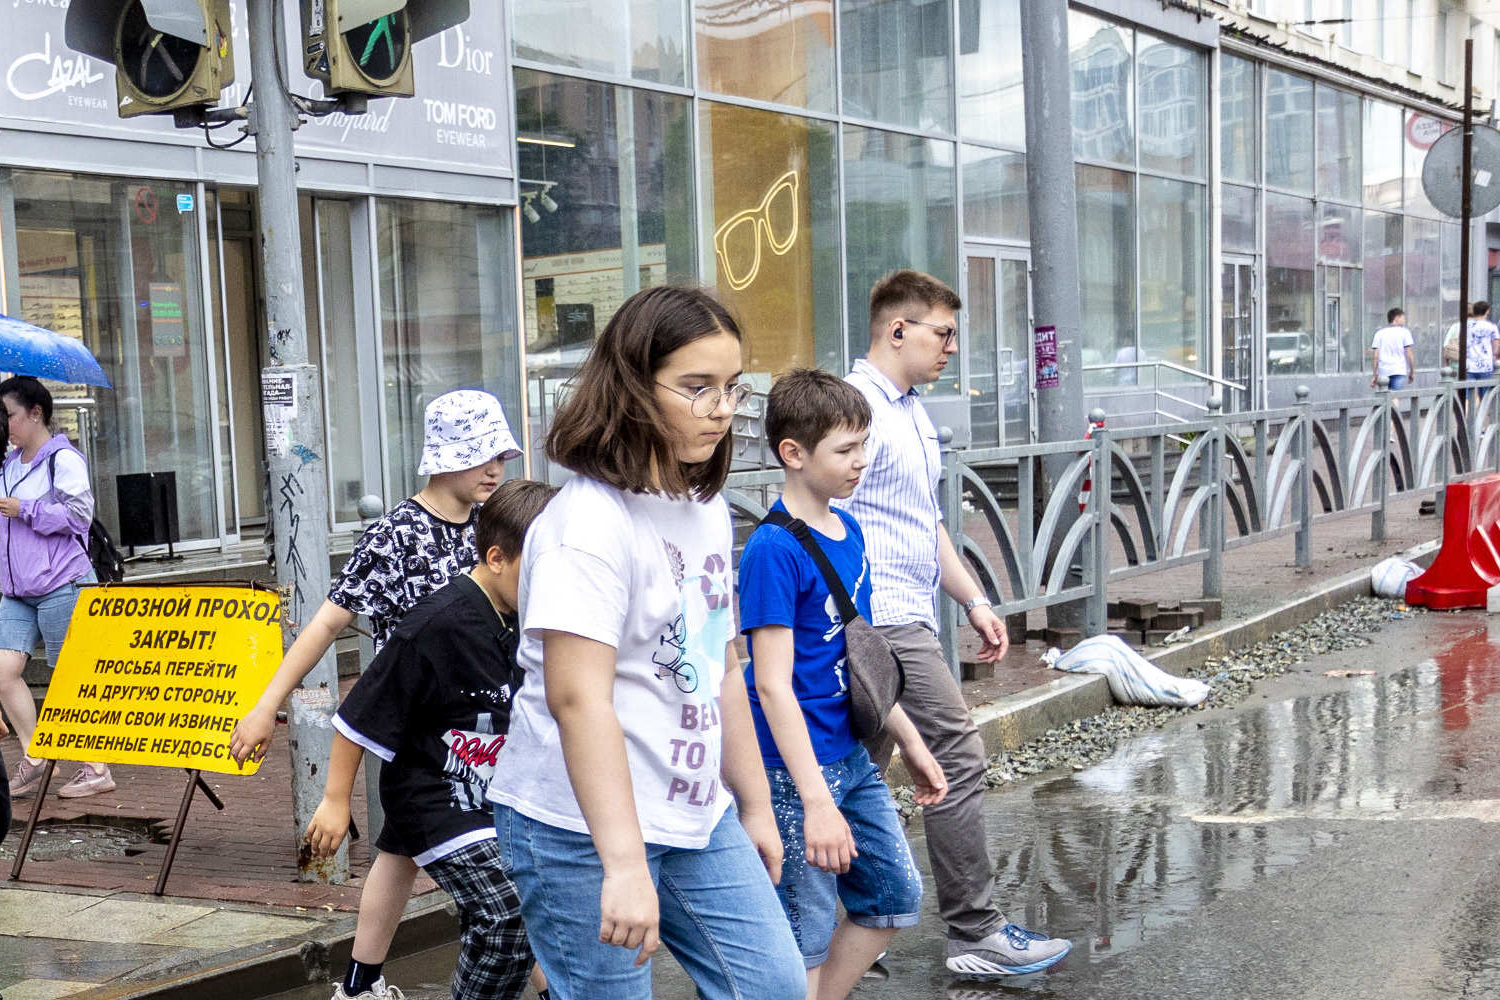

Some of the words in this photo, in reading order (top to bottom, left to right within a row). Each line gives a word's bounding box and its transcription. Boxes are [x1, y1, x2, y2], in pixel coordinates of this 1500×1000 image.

[437, 23, 493, 75] Dior
[6, 32, 104, 100] CAZAL
[67, 95, 109, 110] EYEWEAR
[423, 99, 457, 125] TOM
[458, 103, 496, 131] FORD
[436, 129, 486, 148] EYEWEAR
[88, 593, 191, 618] СКВОЗНОЙ
[128, 629, 217, 650] ЗАКРЫТ!
[94, 659, 161, 676] ПРОСЬБА
[165, 660, 238, 680] ПЕРЕЙТИ
[77, 684, 97, 699] НА
[99, 685, 160, 702] ДРУГУЮ
[163, 686, 239, 707] СТОРОНУ.
[41, 708, 121, 725] ПРИНОСИМ
[124, 711, 165, 729] СВОИ
[168, 713, 239, 733] ИЗВИНЕ
[36, 733, 53, 748] ЗА
[56, 733, 149, 752] ВРЕМЕННЫЕ
[670, 738, 706, 770] TO
